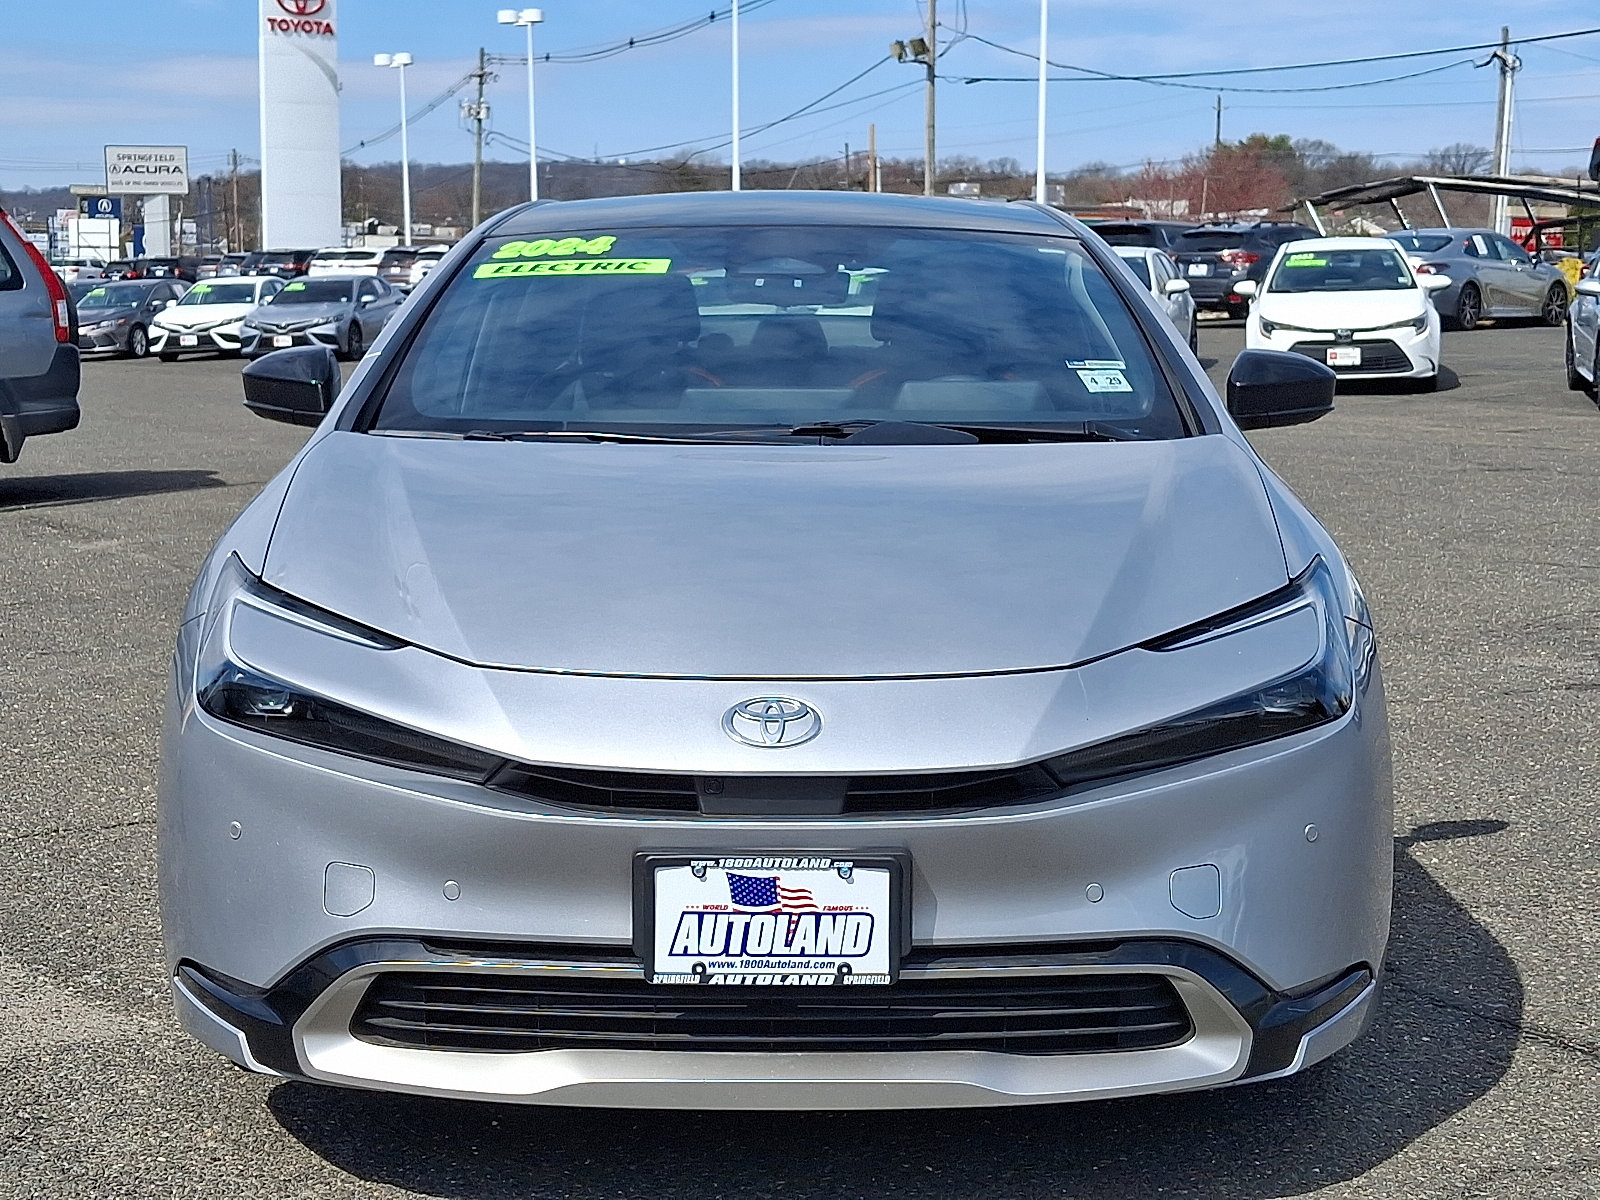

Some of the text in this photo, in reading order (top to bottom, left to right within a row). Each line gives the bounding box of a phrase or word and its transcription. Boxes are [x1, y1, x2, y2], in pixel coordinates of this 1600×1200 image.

[267, 18, 333, 36] TOYOTA
[117, 153, 175, 162] SPRINGFIELD
[122, 165, 183, 174] ACURA
[492, 235, 617, 259] 2024
[493, 261, 650, 274] ELECTRIC
[1090, 376, 1122, 385] 4 29
[668, 911, 875, 958] AUTOLAND
[708, 960, 836, 969] www.1800Autoland.com
[652, 974, 891, 986] SPRINGFIELD AUTOLAND SPRINGFIELD
